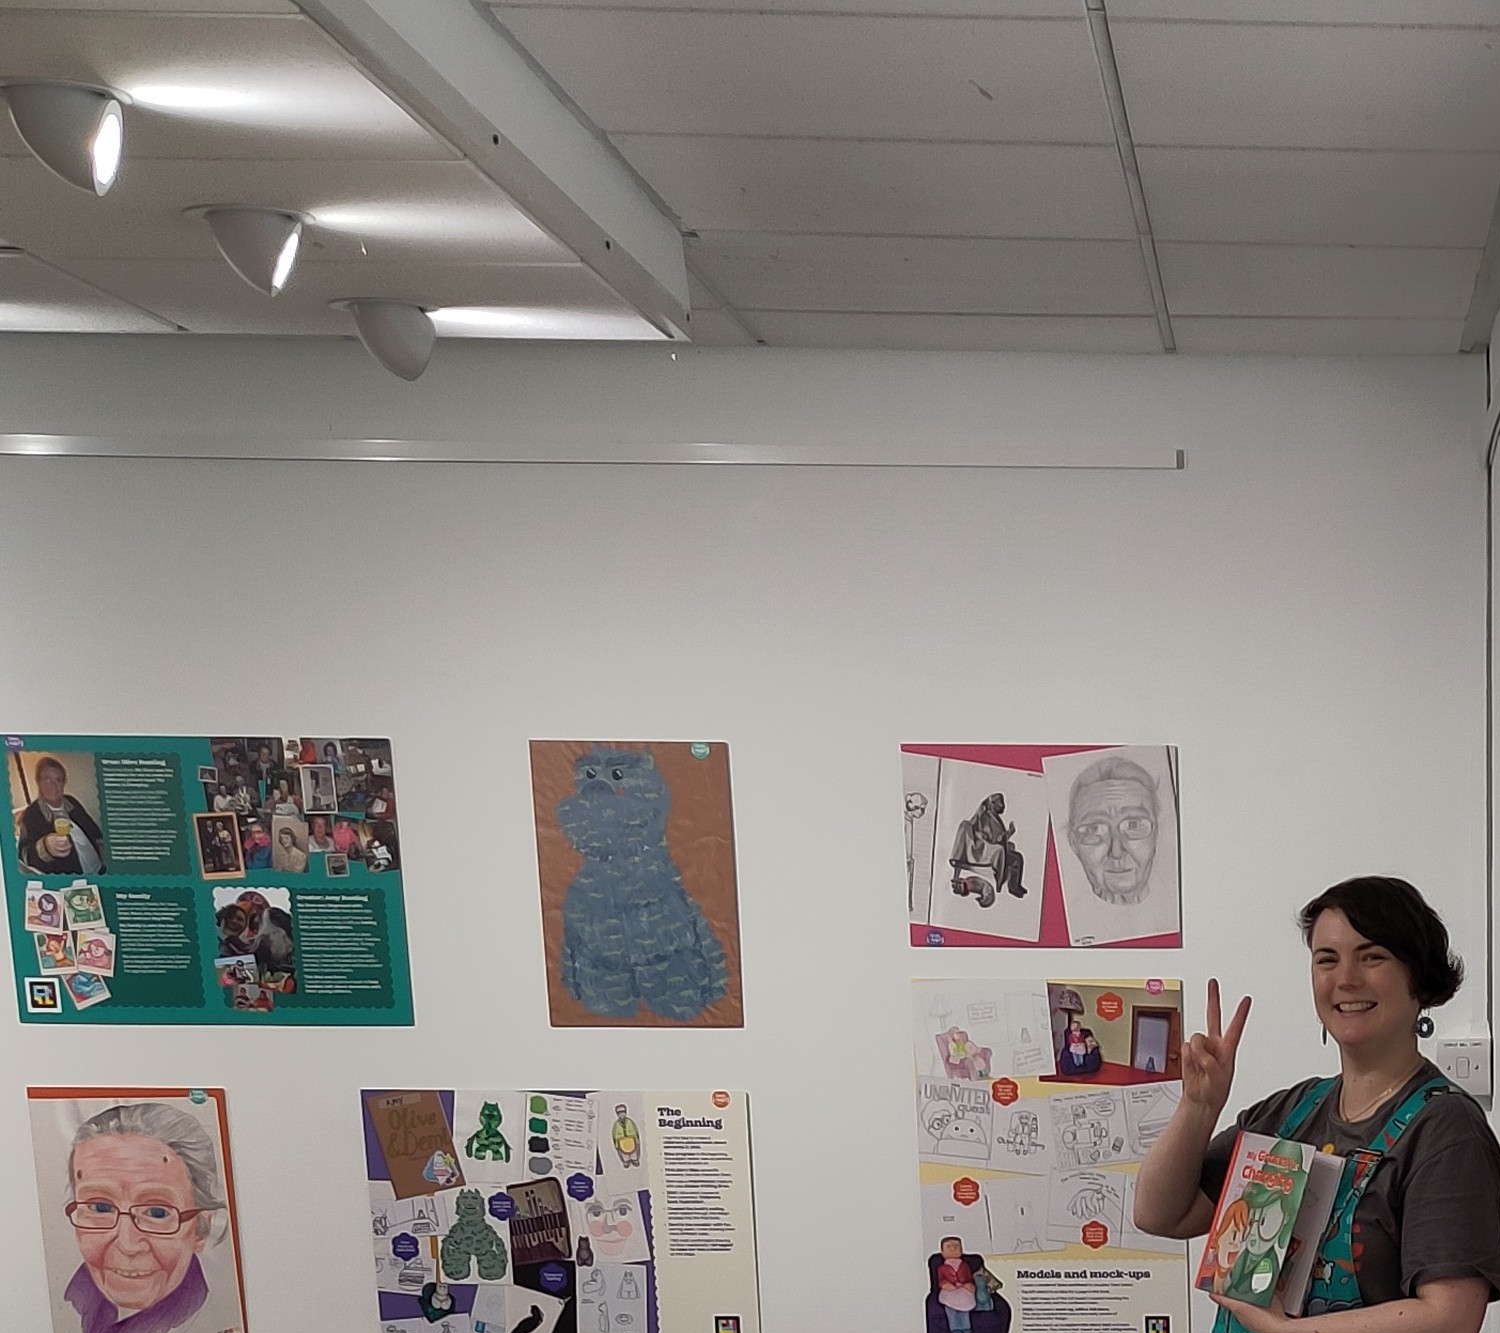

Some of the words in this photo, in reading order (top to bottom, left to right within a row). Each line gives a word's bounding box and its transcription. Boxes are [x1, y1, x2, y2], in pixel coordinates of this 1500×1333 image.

[657, 1108, 681, 1116] The
[388, 1108, 436, 1130] Olive
[658, 1117, 722, 1129] Beginning
[1017, 1270, 1062, 1279] Models
[1064, 1270, 1087, 1279] and
[1090, 1270, 1151, 1280] mock-ups
